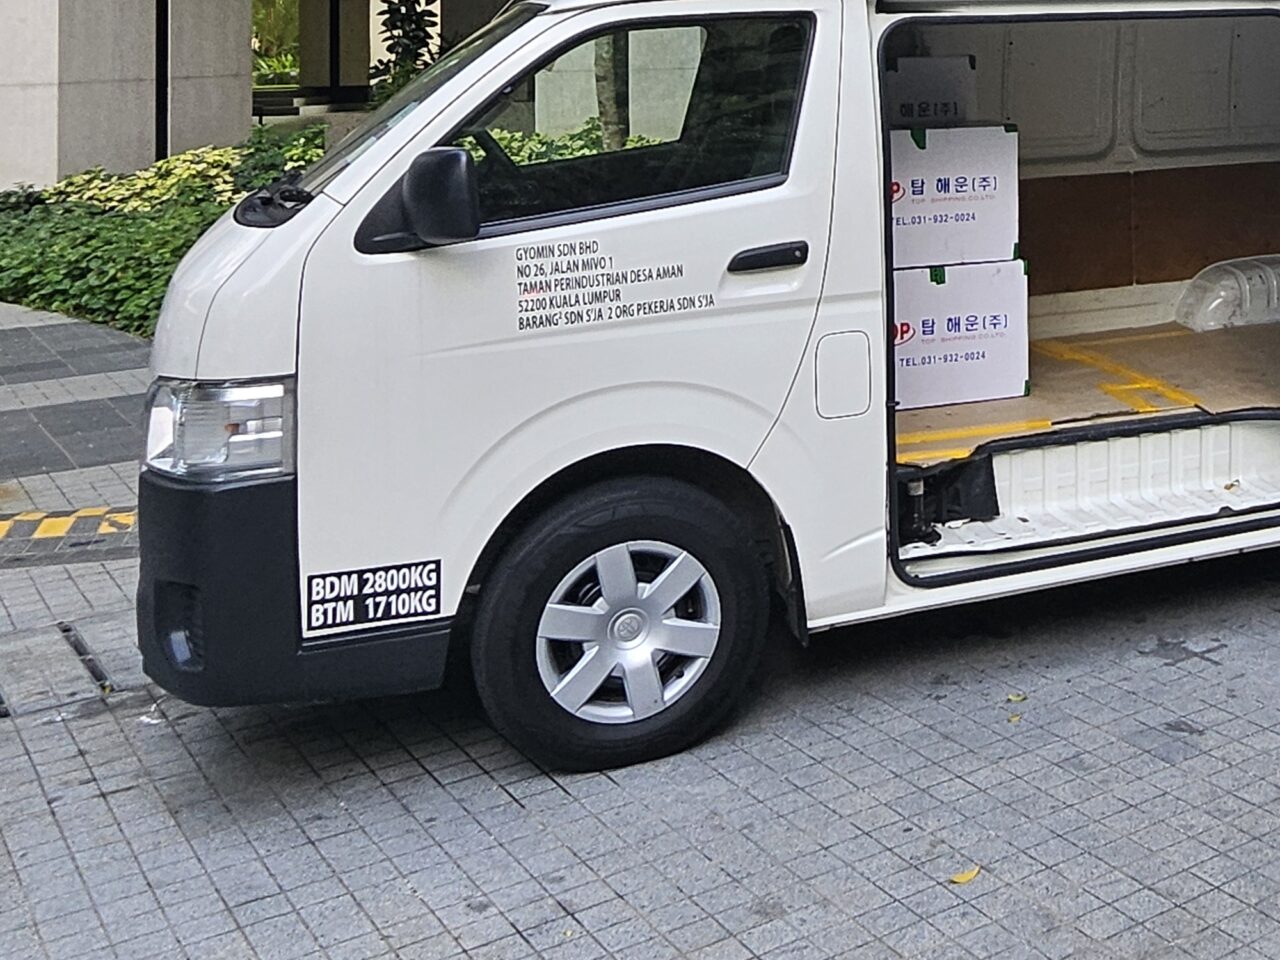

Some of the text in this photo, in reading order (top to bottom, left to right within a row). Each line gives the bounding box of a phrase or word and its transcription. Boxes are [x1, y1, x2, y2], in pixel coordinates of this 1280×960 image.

[911, 178, 926, 196] 탑
[936, 176, 998, 194] 해운(주)
[892, 212, 976, 226] EL.031-932-0024
[516, 240, 599, 261] GYOMIN SDN BHD
[516, 256, 613, 279] NO 26, JALAN MIVO 1
[517, 264, 684, 296] TAMAN PERINDUSTRIAN DESA AMAN
[518, 289, 621, 313] 52200 KUALA LUMPUR
[564, 310, 584, 325] SDN
[607, 306, 613, 320] 2
[615, 304, 635, 319] ORG
[637, 299, 675, 317] PEKERJA
[677, 296, 696, 312] SDN
[921, 318, 936, 336] 탑
[946, 314, 1008, 333] 해운(주)
[899, 351, 986, 367] TEL.031-932-0024
[311, 563, 437, 601] BDM 2800KG
[311, 590, 437, 627] BTM 1710KG
